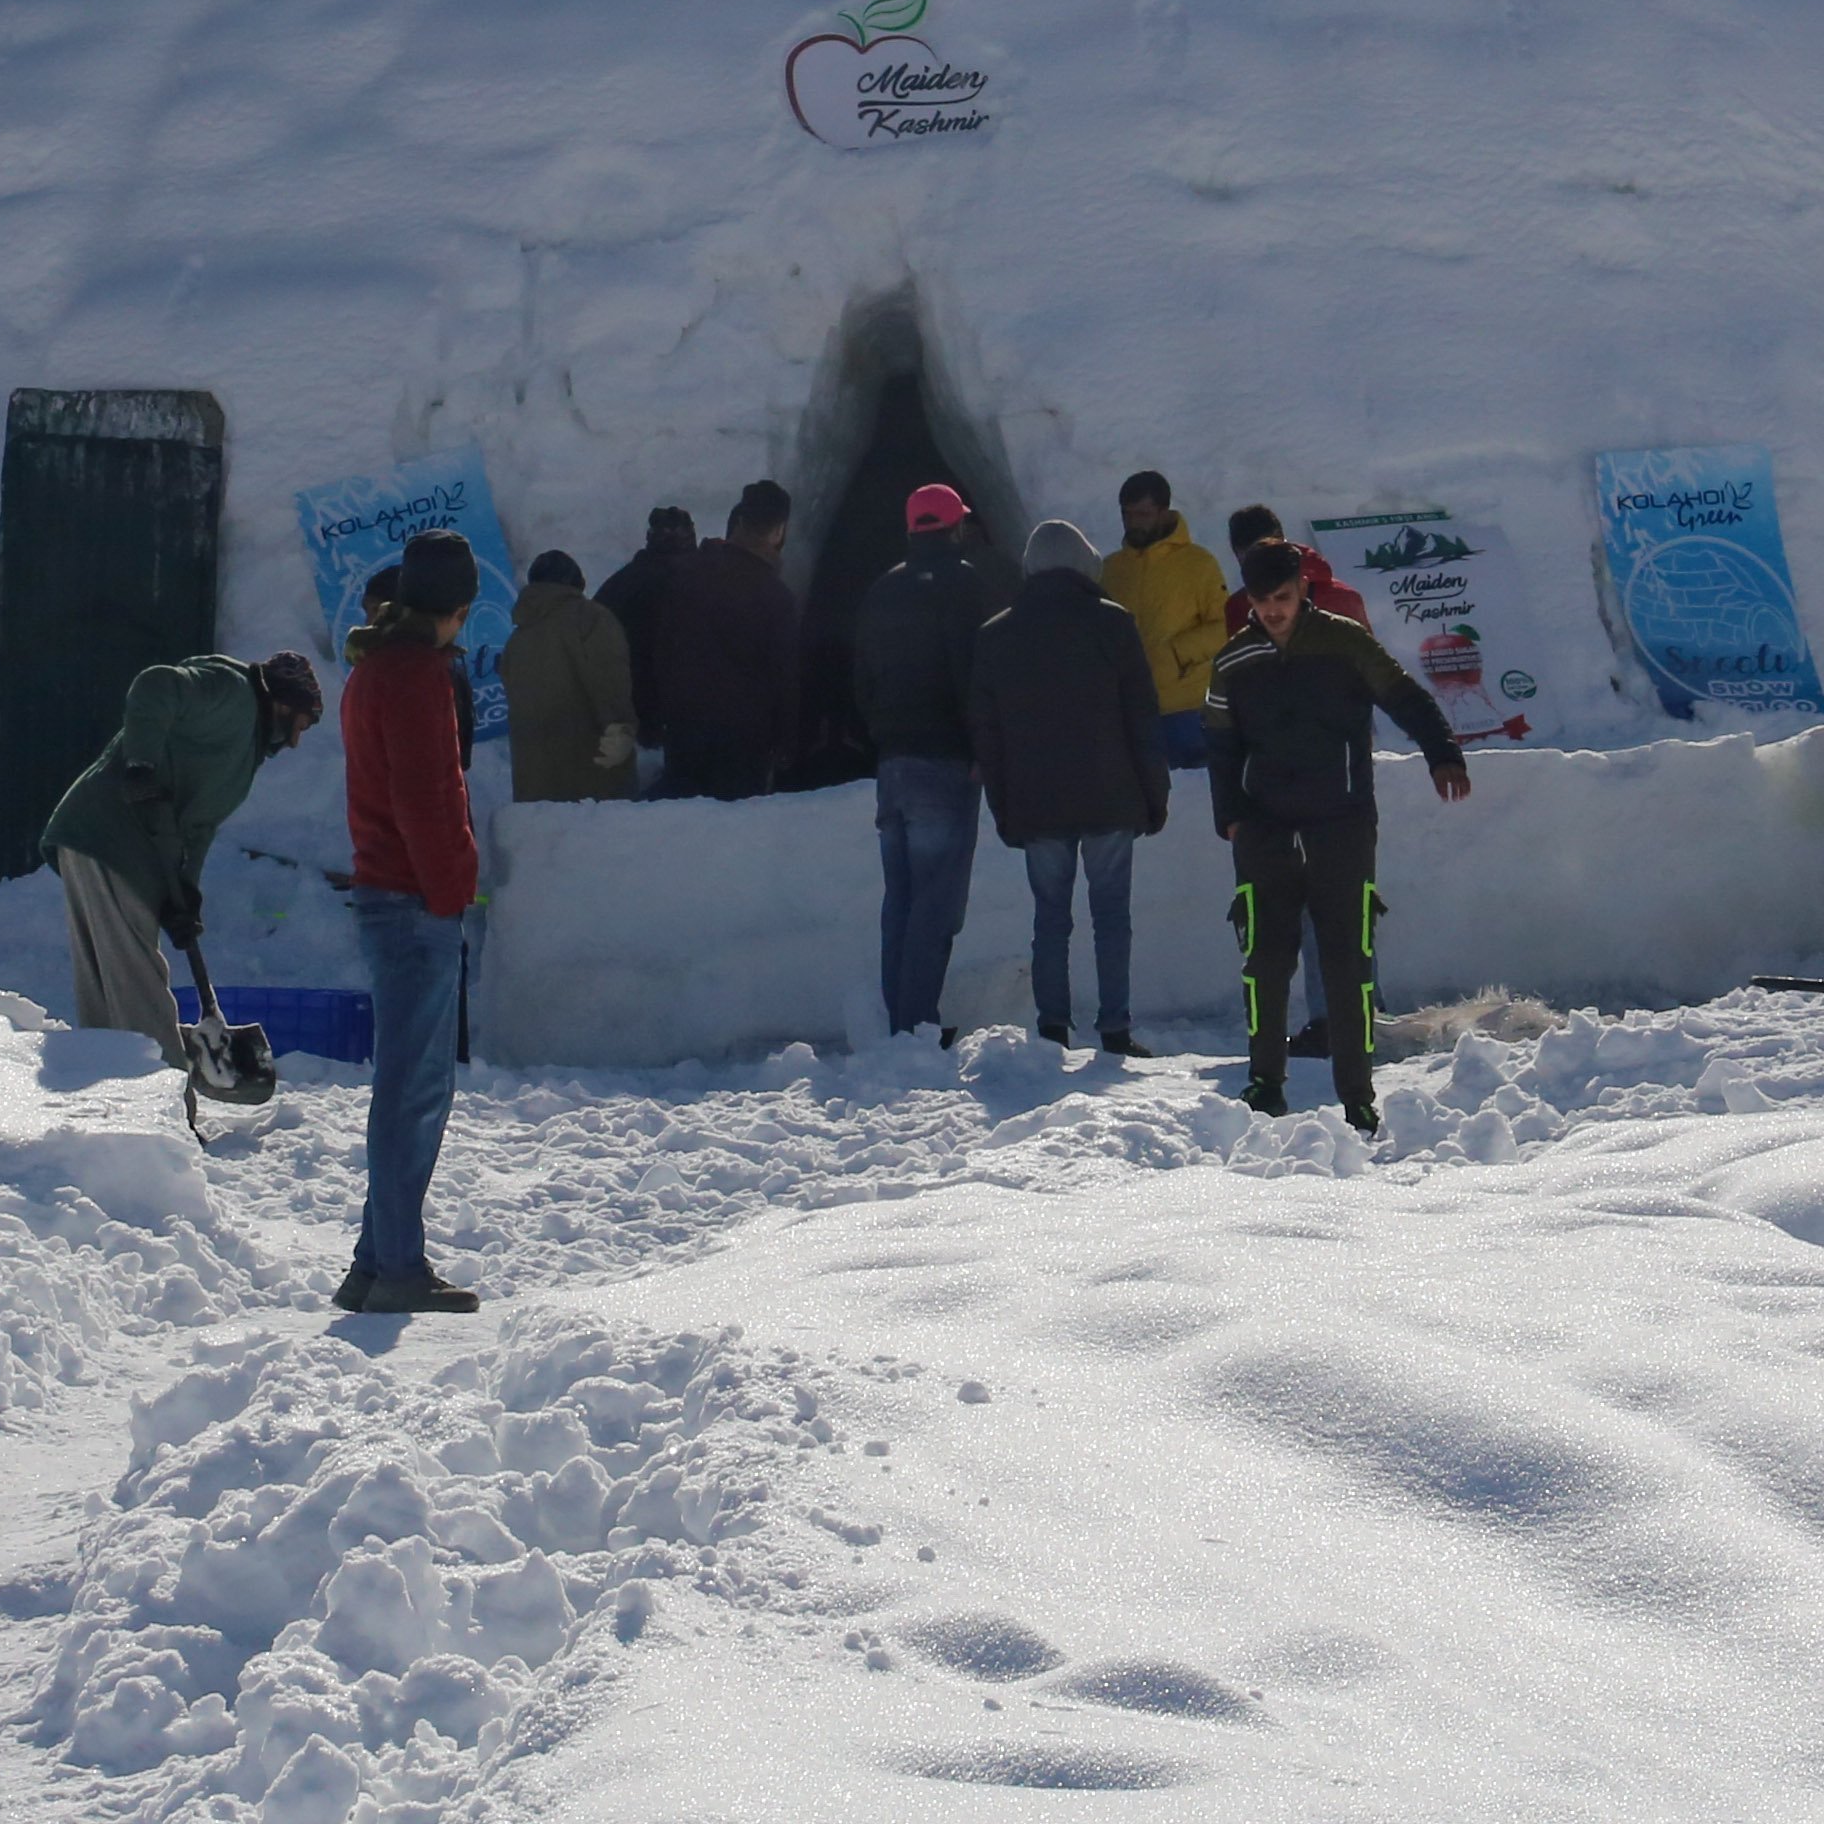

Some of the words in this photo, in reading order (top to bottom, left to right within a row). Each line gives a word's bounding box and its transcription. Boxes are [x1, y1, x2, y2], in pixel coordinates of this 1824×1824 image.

[856, 62, 989, 99] Maiden
[858, 108, 990, 139] Kashmir
[1616, 489, 1726, 511] KOLAHOI
[321, 495, 438, 540] KOLAHOI
[387, 514, 459, 544] Green
[1677, 501, 1743, 531] Green
[1389, 572, 1468, 597] Maiden
[1395, 600, 1476, 624] Kashmir
[1708, 679, 1795, 696] SNOW
[1728, 699, 1818, 714] GLOO
